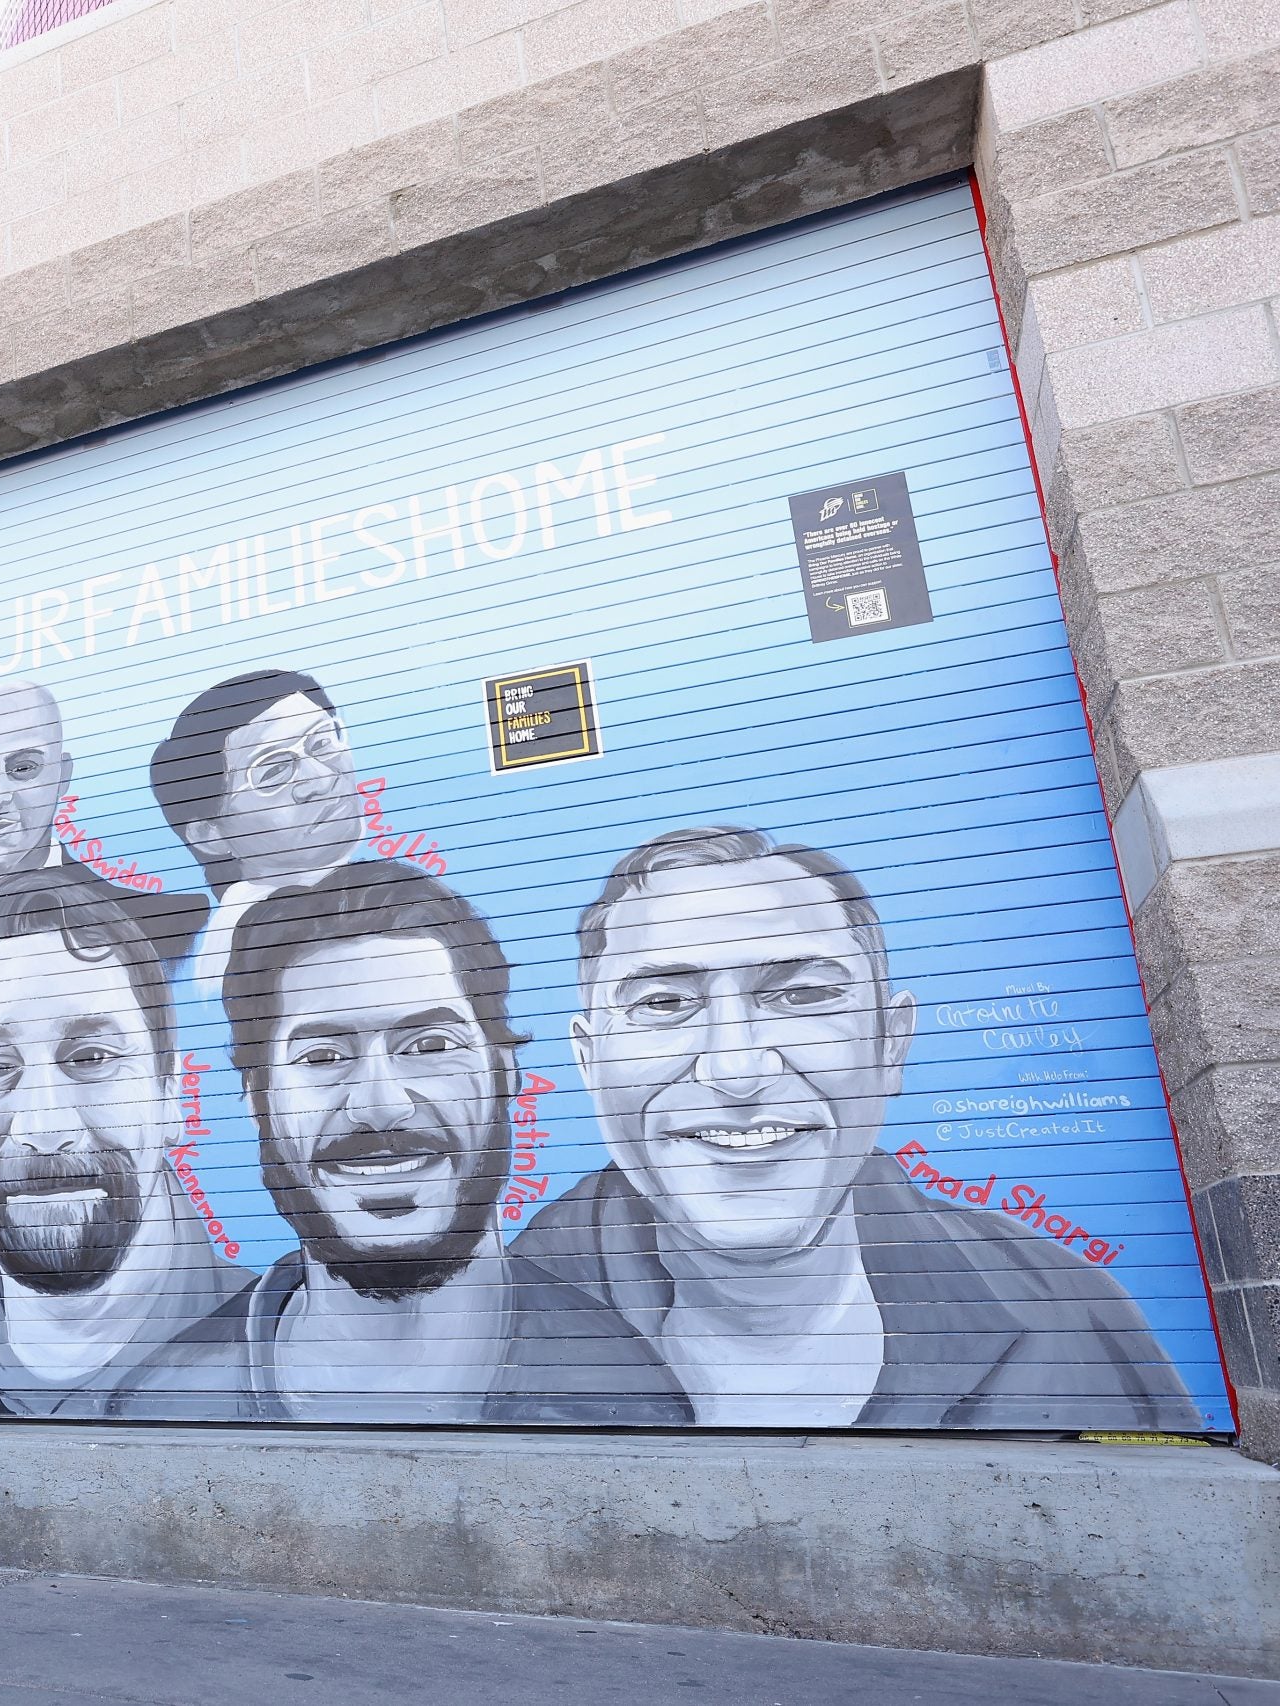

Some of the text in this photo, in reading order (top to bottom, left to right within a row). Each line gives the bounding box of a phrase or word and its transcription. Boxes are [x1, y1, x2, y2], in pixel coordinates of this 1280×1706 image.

[504, 685, 534, 702] BRING
[505, 701, 527, 716] OUR
[507, 710, 551, 730] FAMILIES
[509, 728, 538, 744] HOME.
[54, 795, 163, 893] Mark Swidan
[356, 777, 447, 876] David Lin
[1006, 982, 1052, 996] Mural By
[168, 1052, 242, 1260] Jerrel Kenemore
[502, 1072, 557, 1221] Austin Tice
[895, 1139, 1125, 1265] Emad Shargi
